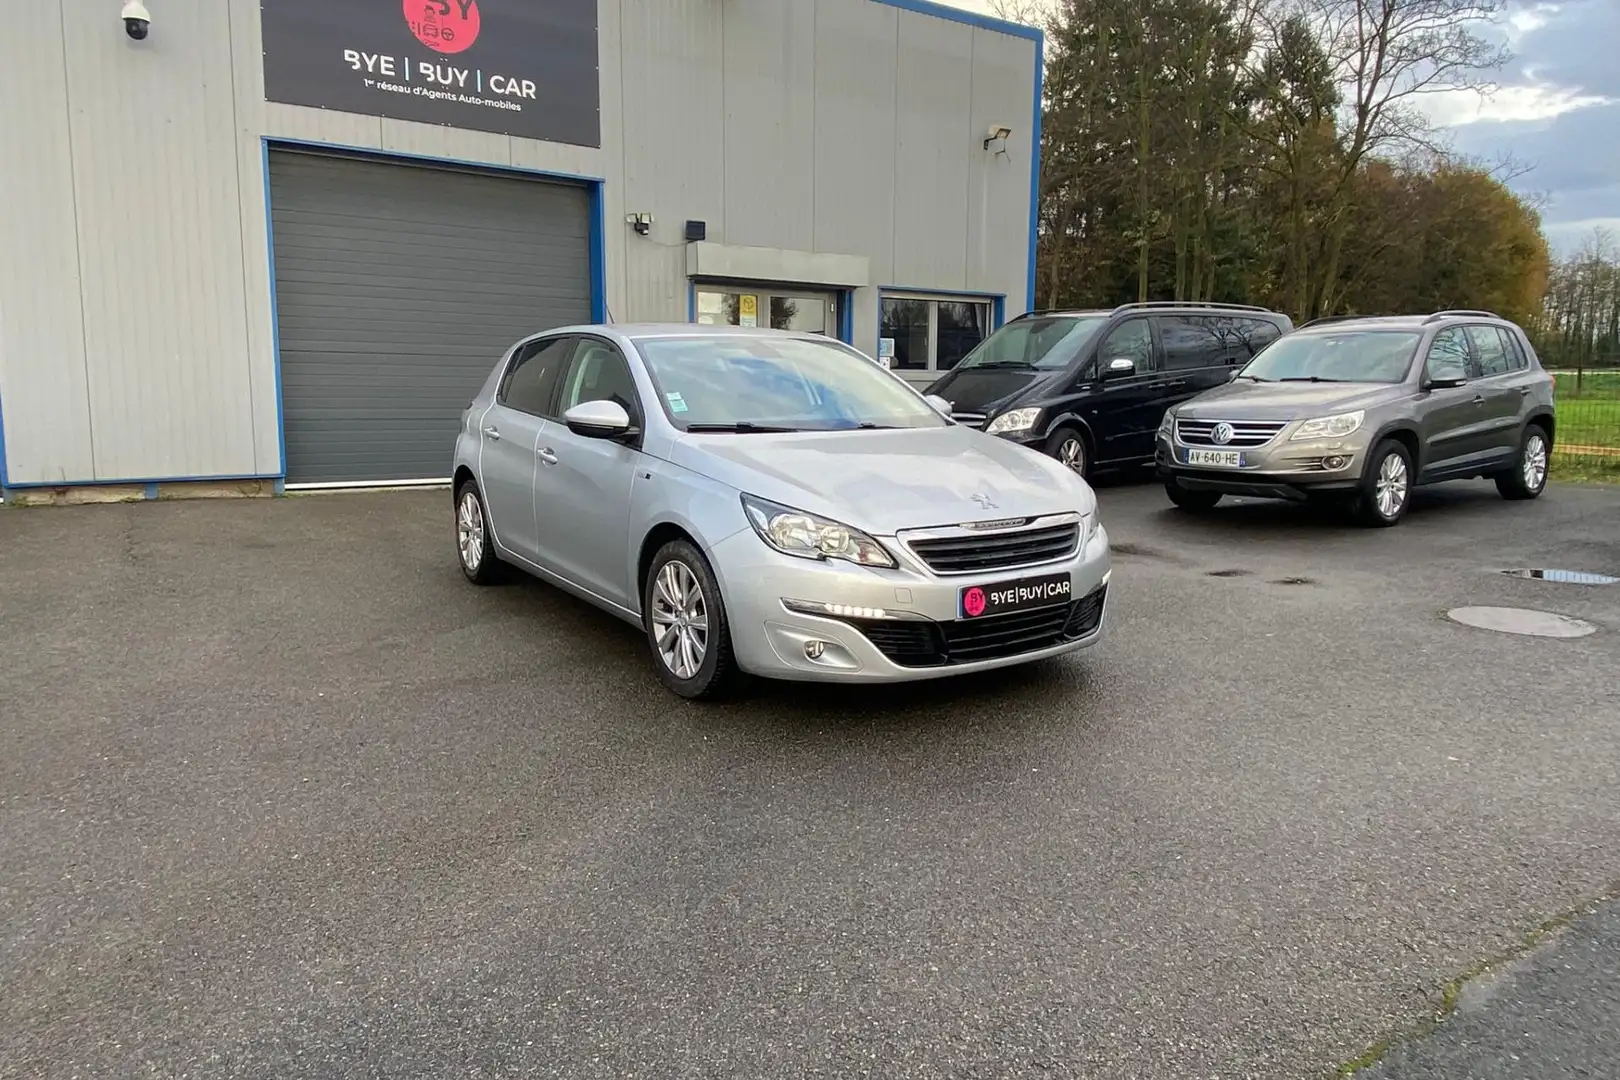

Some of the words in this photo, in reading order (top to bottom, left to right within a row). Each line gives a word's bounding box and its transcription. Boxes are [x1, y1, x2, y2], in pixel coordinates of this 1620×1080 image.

[344, 49, 395, 77] BYE
[419, 61, 469, 88] BUY
[489, 75, 537, 100] CAR
[377, 81, 411, 94] réseau
[413, 85, 457, 102] d'Agents
[458, 93, 522, 112] Auto-mobiles
